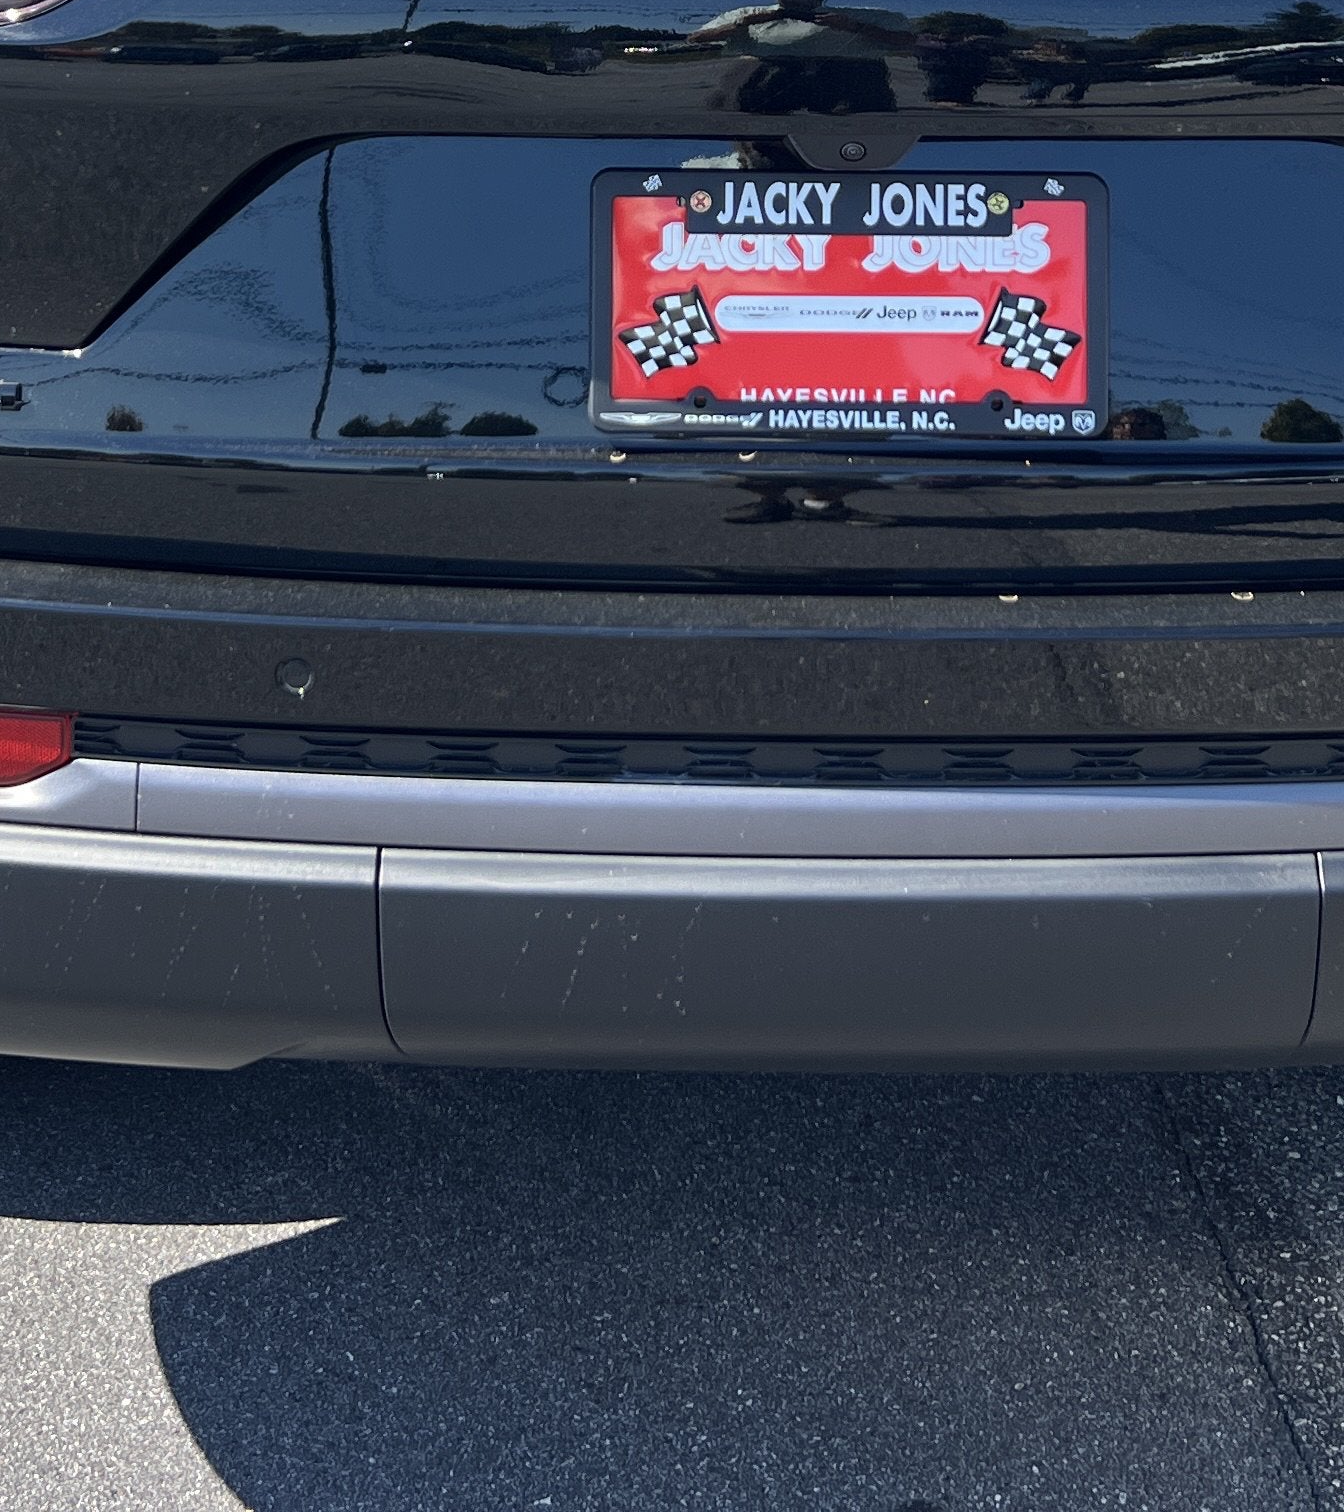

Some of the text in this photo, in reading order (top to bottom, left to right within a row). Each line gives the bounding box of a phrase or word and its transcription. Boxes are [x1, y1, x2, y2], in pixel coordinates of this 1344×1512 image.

[716, 181, 988, 227] JACKY JONES
[650, 221, 1052, 273] JACKY JONES
[876, 304, 917, 321] Jeep
[768, 409, 906, 431] HAYESVILLE,
[911, 410, 956, 431] N.C.
[1003, 407, 1066, 434] Jeep
